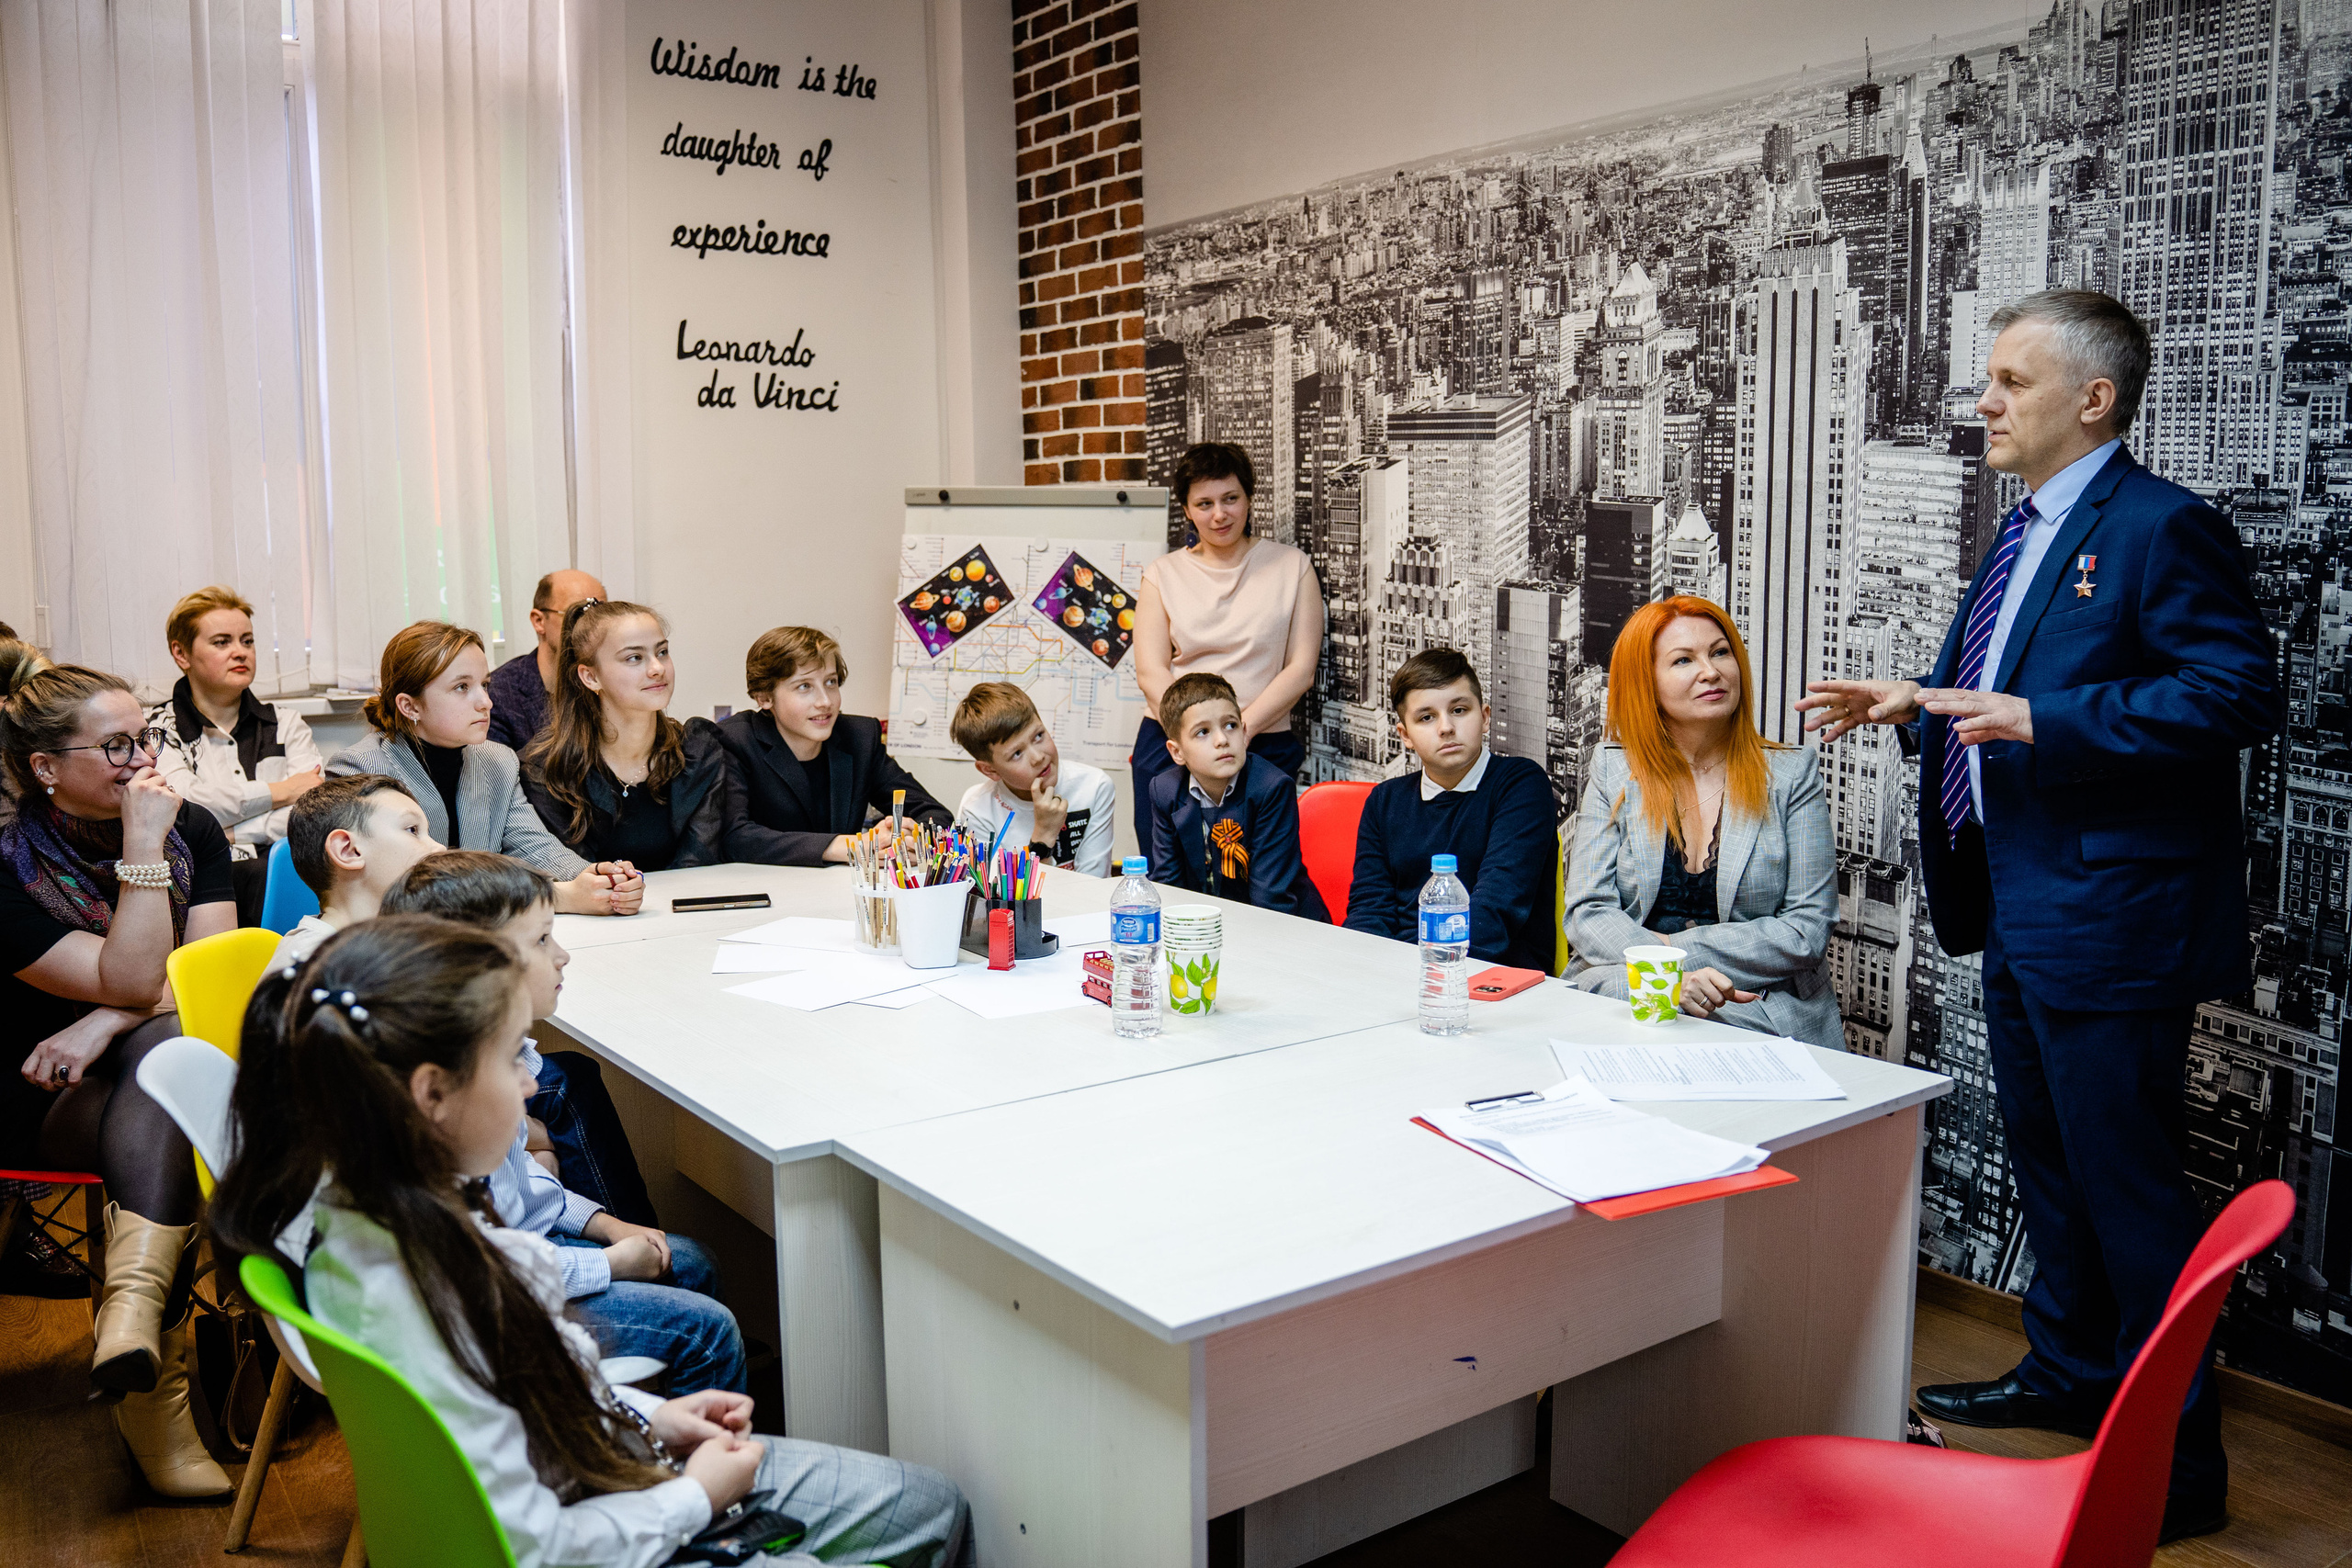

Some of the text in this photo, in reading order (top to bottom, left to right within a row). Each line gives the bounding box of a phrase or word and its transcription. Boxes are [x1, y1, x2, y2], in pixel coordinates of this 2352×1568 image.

[650, 37, 876, 100] Wisdom is the
[661, 122, 832, 181] daughter of
[672, 220, 830, 259] experience
[677, 320, 815, 367] Leonardo
[698, 369, 839, 412] da Vinci
[1068, 818, 1088, 829] SKATE
